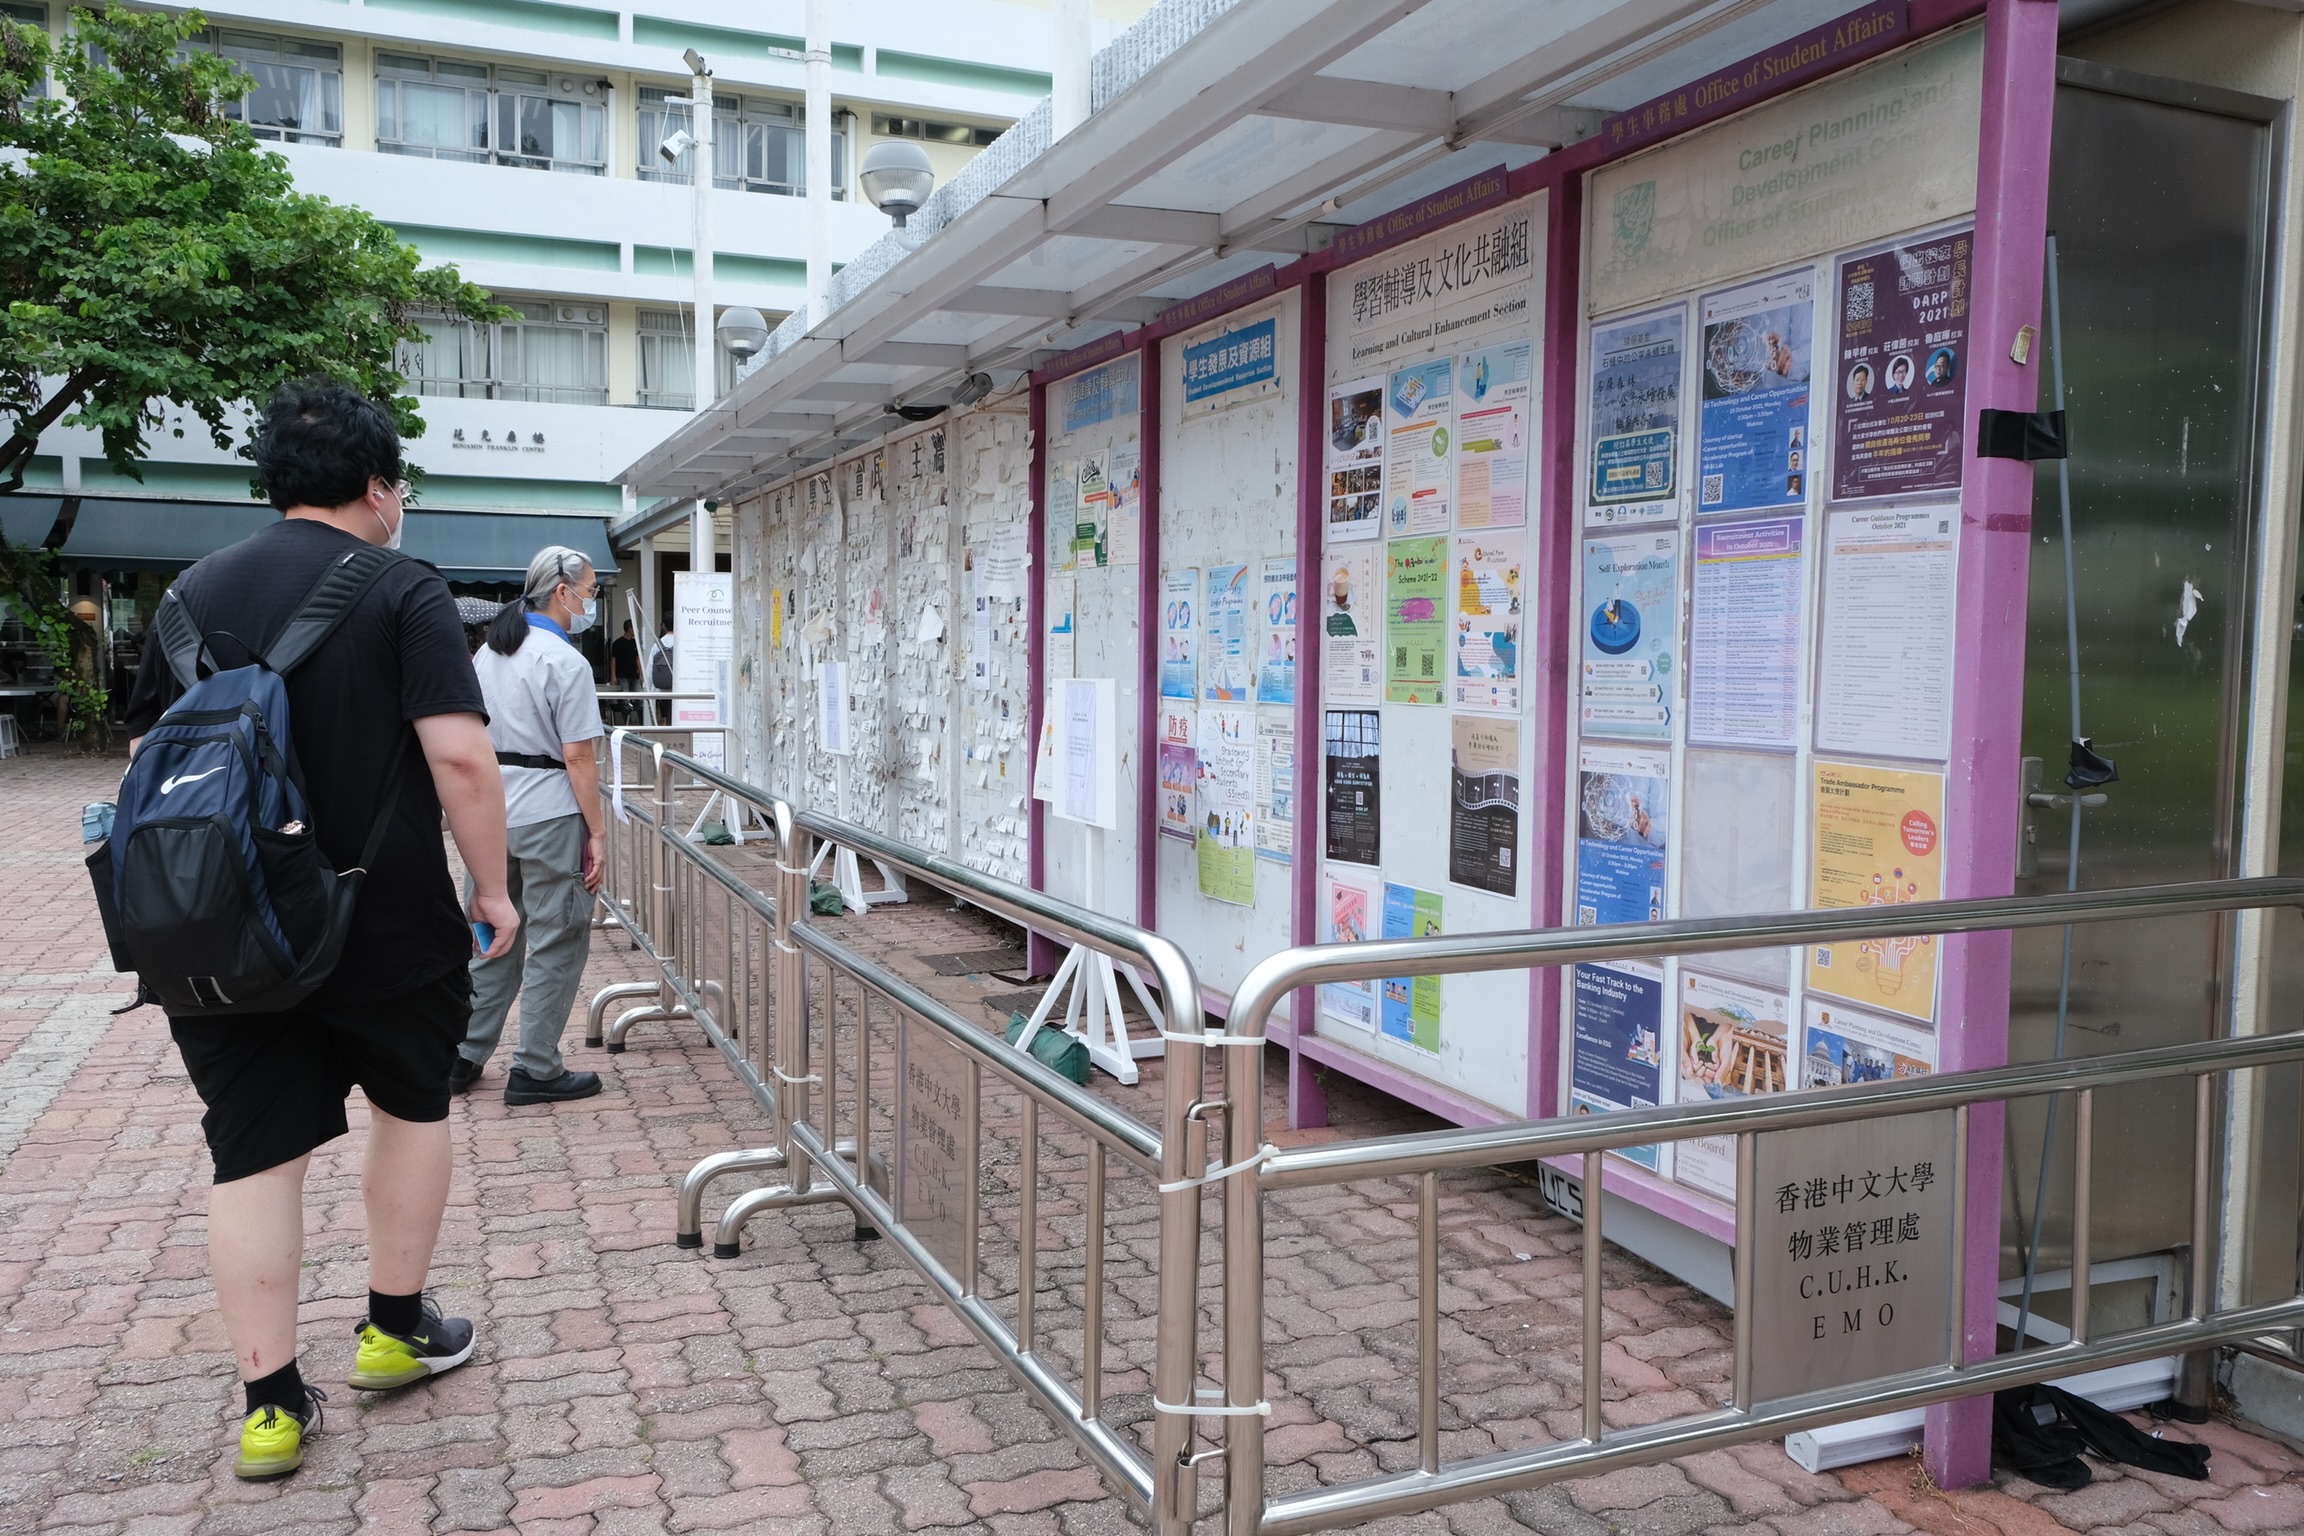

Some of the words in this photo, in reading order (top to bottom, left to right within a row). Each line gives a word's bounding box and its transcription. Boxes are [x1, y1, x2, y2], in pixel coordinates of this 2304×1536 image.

[1695, 74, 1740, 109] Office
[1743, 62, 1760, 88] of
[1763, 42, 1827, 80] Student
[1833, 8, 1895, 52] Affairs
[1611, 94, 1689, 144] 學生事務處
[1739, 132, 1801, 171] Career
[1809, 99, 1903, 147] Planning
[1732, 148, 1861, 207] Development
[1388, 210, 1414, 236] Office
[1416, 205, 1425, 223] of
[1426, 192, 1463, 219] Student
[1466, 176, 1500, 202] Affairs
[1339, 222, 1384, 254] 學生事務處
[1353, 220, 1528, 322] 學習輔導及文化共融組
[1200, 298, 1215, 312] Office
[1216, 294, 1223, 305] of
[1223, 285, 1247, 302] Student
[1249, 272, 1270, 291] Affairs
[1913, 291, 1948, 309] DARP
[1919, 307, 1947, 324] 2021
[1353, 340, 1383, 360] Learning
[1385, 331, 1399, 349] and
[1401, 321, 1432, 343] Cultural
[1435, 308, 1490, 335] Enhancement
[1493, 298, 1526, 317] Section
[1189, 334, 1271, 382] 學生發展及資源組
[1188, 385, 1201, 396] Student
[1236, 370, 1255, 380] Resources
[1257, 365, 1272, 375] Section
[1711, 398, 1739, 408] Technology
[1769, 385, 1808, 397] Opportunities
[1727, 433, 1743, 441] startup
[1852, 515, 1869, 524] Career
[1870, 514, 1895, 522] Guidance
[1895, 513, 1929, 521] Programmes
[1716, 532, 1753, 541] Recruitment
[1755, 529, 1784, 538] Activities
[1734, 542, 1758, 550] October
[1395, 559, 1403, 567] The
[1599, 564, 1610, 573] Self
[1613, 562, 1647, 574] Exploration
[1649, 560, 1669, 570] Month
[1399, 574, 1416, 584] Scheme
[1169, 715, 1187, 737] 防疫
[1216, 755, 1234, 766] Scheme
[1236, 759, 1245, 767] for
[1222, 746, 1249, 761] Shadowing
[1216, 776, 1238, 788] Students
[1220, 767, 1249, 781] Secondary
[1820, 778, 1836, 786] Trade
[1836, 780, 1870, 790] Ambassador
[1871, 784, 1905, 794] Programme
[1903, 826, 1934, 836] Tomorrow's
[1909, 820, 1927, 829] Calling
[1586, 841, 1609, 850] Technology
[1634, 848, 1664, 857] Opportunities
[1908, 834, 1929, 842] Leaders
[1577, 969, 1591, 980] Your
[1592, 973, 1605, 984] Fast
[1606, 977, 1624, 989] Track
[1625, 982, 1631, 991] to
[1633, 984, 1643, 994] the
[1577, 980, 1601, 995] Banking
[1602, 987, 1627, 1002] Industry
[1576, 1032, 1598, 1043] Excellence
[1603, 1040, 1611, 1048] ESG
[1834, 1018, 1847, 1027] Career
[1848, 1022, 1867, 1033] Planning
[1868, 1027, 1876, 1035] and
[1877, 1030, 1905, 1044] Development
[1906, 1039, 1921, 1049] Centre
[908, 1062, 961, 1121] 香港中文大學
[911, 1104, 955, 1161] 物業管理處
[1697, 1138, 1725, 1156] Board
[915, 1143, 950, 1192] C.U.H.K.
[1775, 1162, 1934, 1214] 香港中文大學
[1788, 1213, 1920, 1262] 物業管理處
[1800, 1260, 1907, 1299] C.U.H.K.
